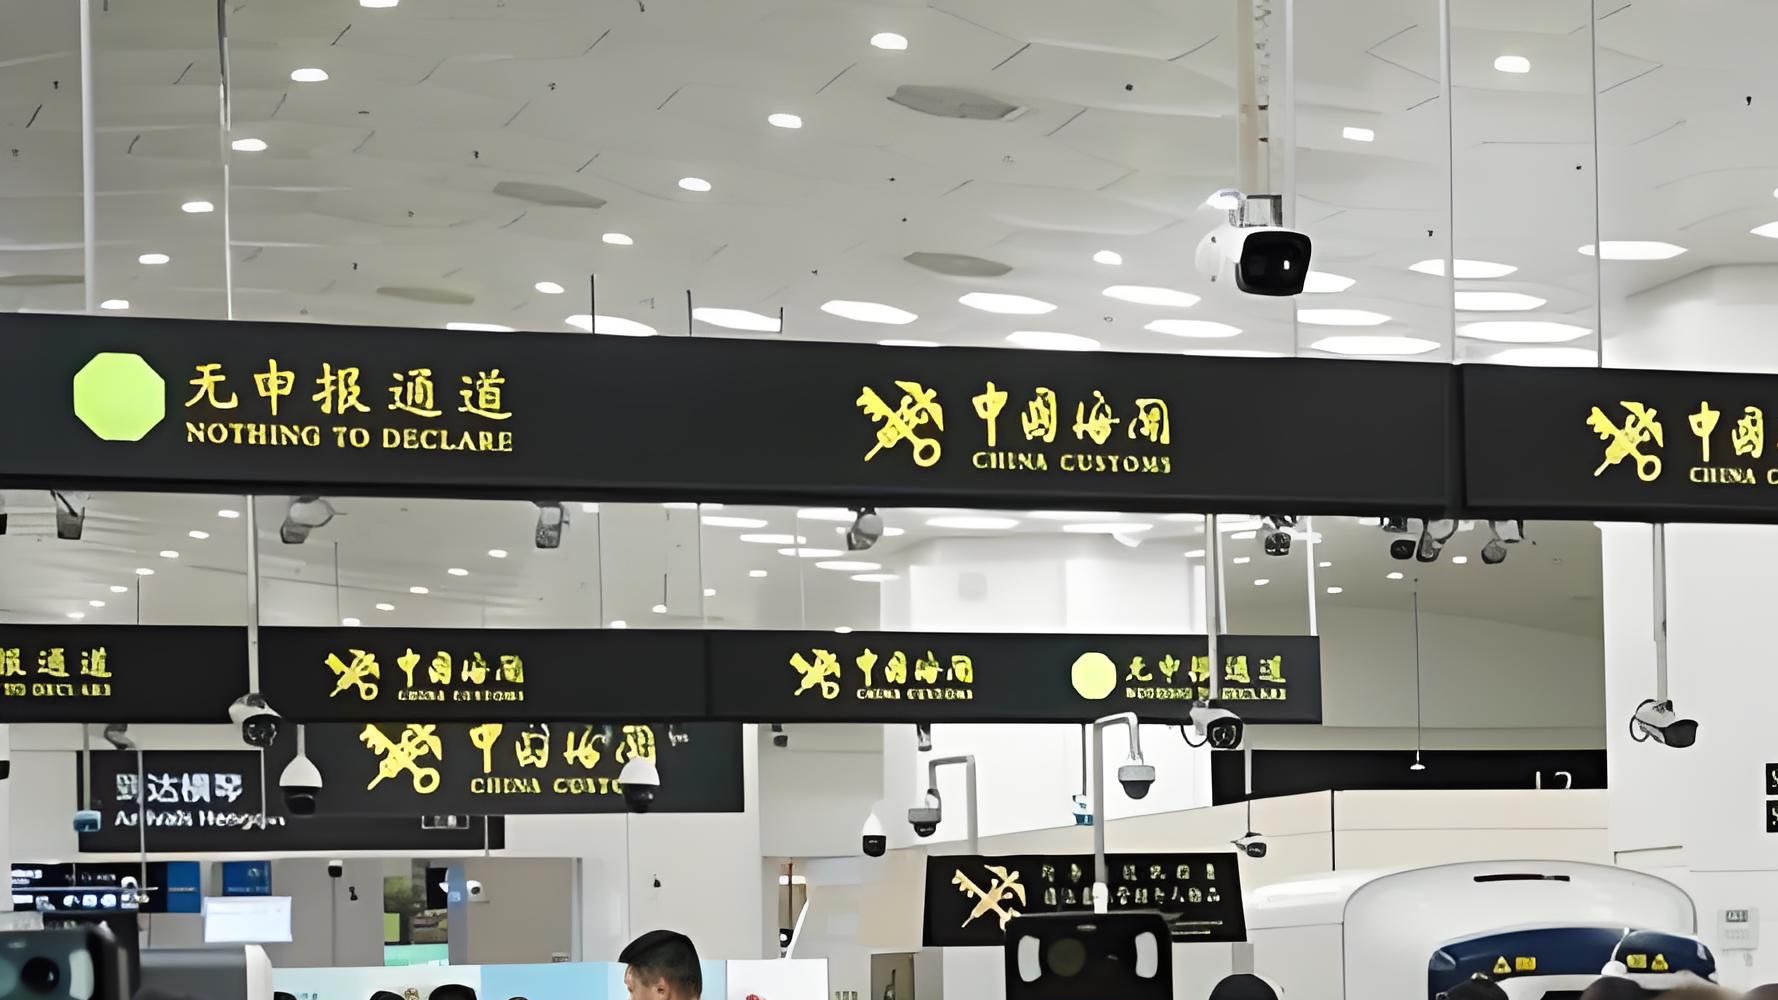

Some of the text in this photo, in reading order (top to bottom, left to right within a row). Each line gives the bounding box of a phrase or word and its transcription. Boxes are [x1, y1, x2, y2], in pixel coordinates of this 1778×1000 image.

[184, 358, 513, 419] 无申报通道
[185, 421, 513, 452] NOTHING TO DECLARE
